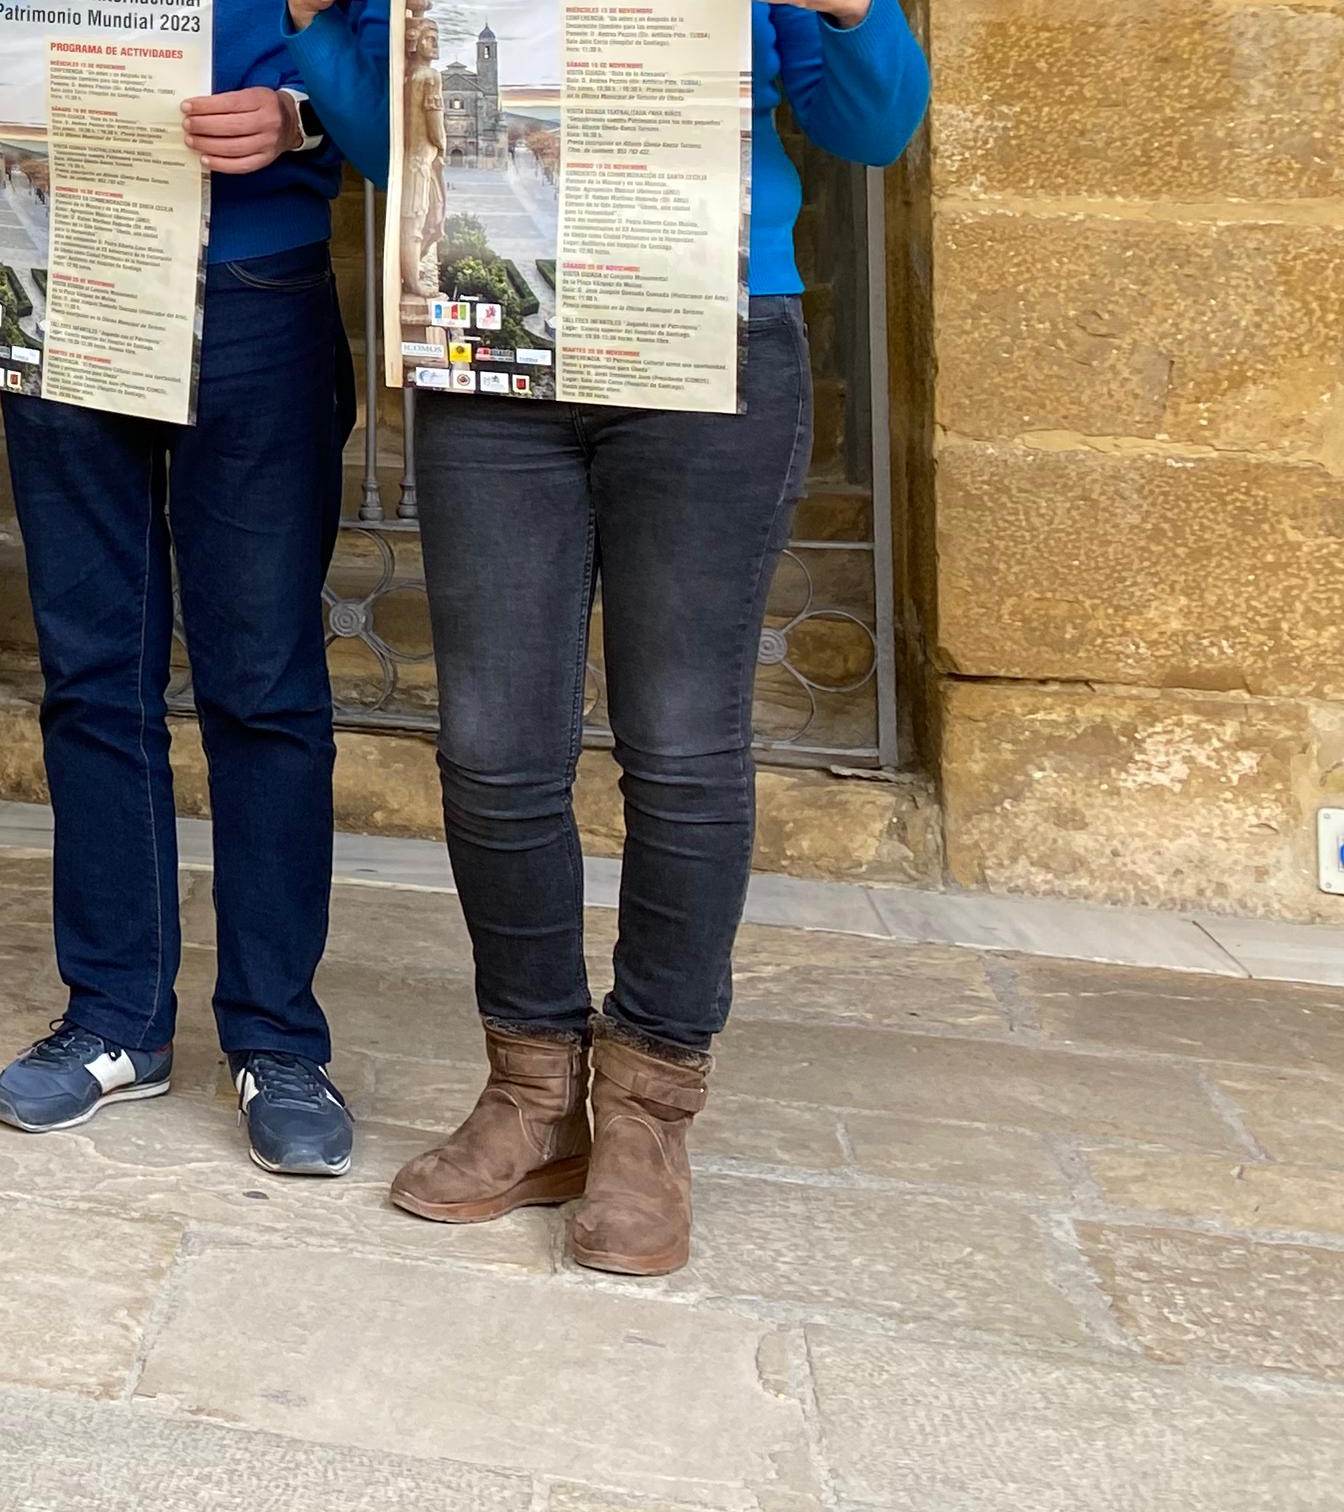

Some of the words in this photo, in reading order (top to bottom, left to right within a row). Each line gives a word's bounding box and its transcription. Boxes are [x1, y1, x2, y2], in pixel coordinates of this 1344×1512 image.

[88, 9, 154, 30] Mundial
[160, 14, 200, 33] 2023
[50, 42, 102, 54] PROGRAMA
[106, 45, 118, 56] DE
[120, 46, 184, 59] ACTIVIDADES
